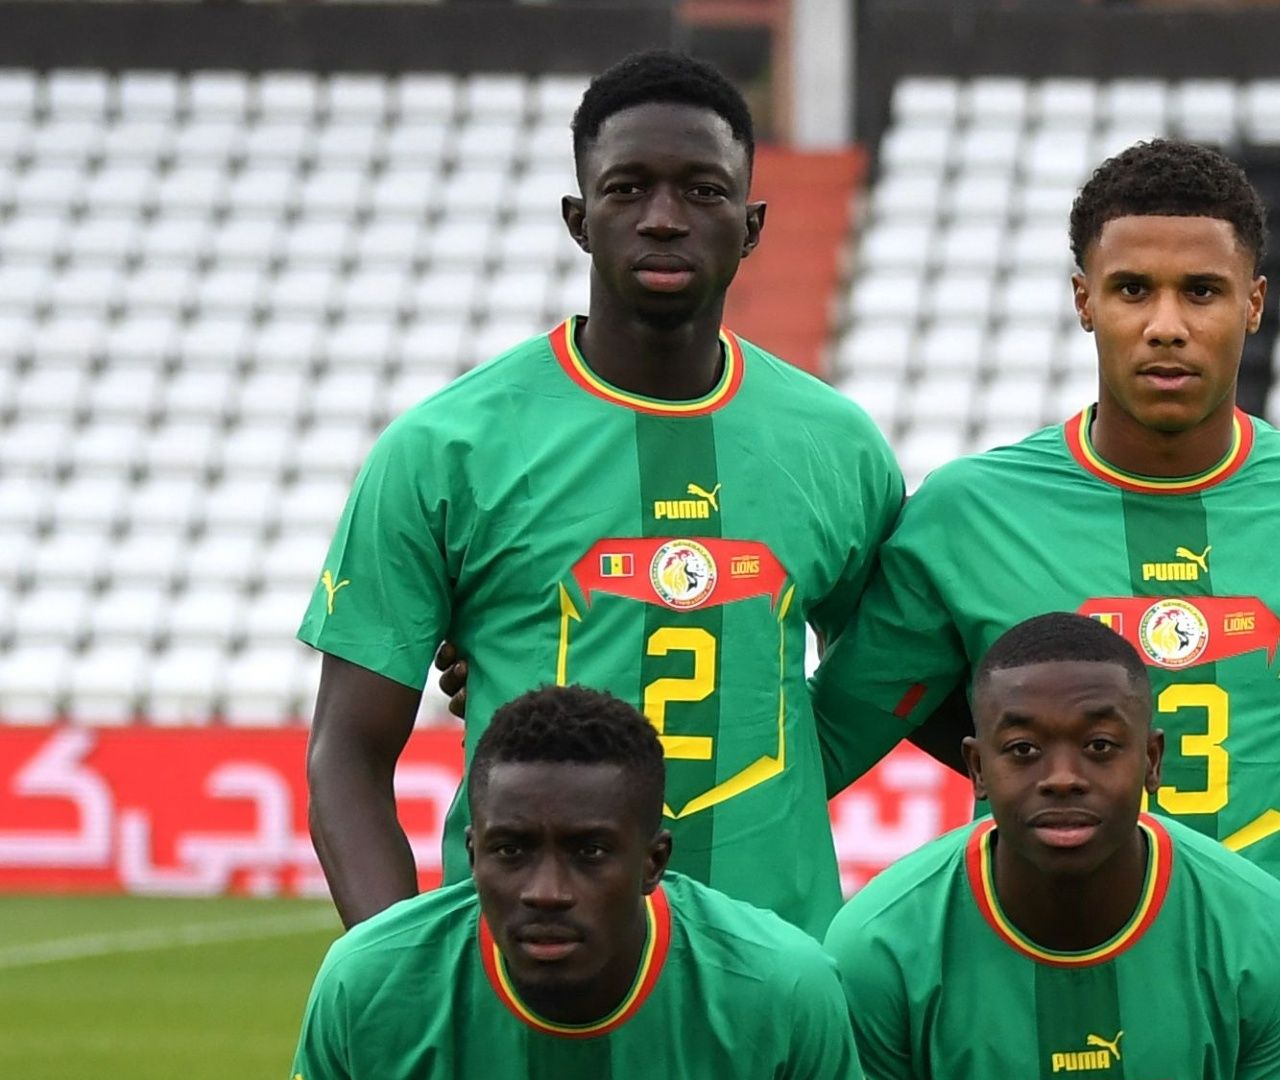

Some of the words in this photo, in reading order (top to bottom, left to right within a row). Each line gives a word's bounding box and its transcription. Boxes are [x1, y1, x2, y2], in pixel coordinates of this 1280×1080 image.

[654, 500, 709, 519] PUMA
[731, 561, 759, 574] LIONS
[1142, 563, 1198, 581] PUMA
[1224, 617, 1255, 632] LIONS
[644, 627, 716, 760] 2
[1157, 684, 1229, 814] 3
[1052, 1050, 1110, 1072] PUMA
